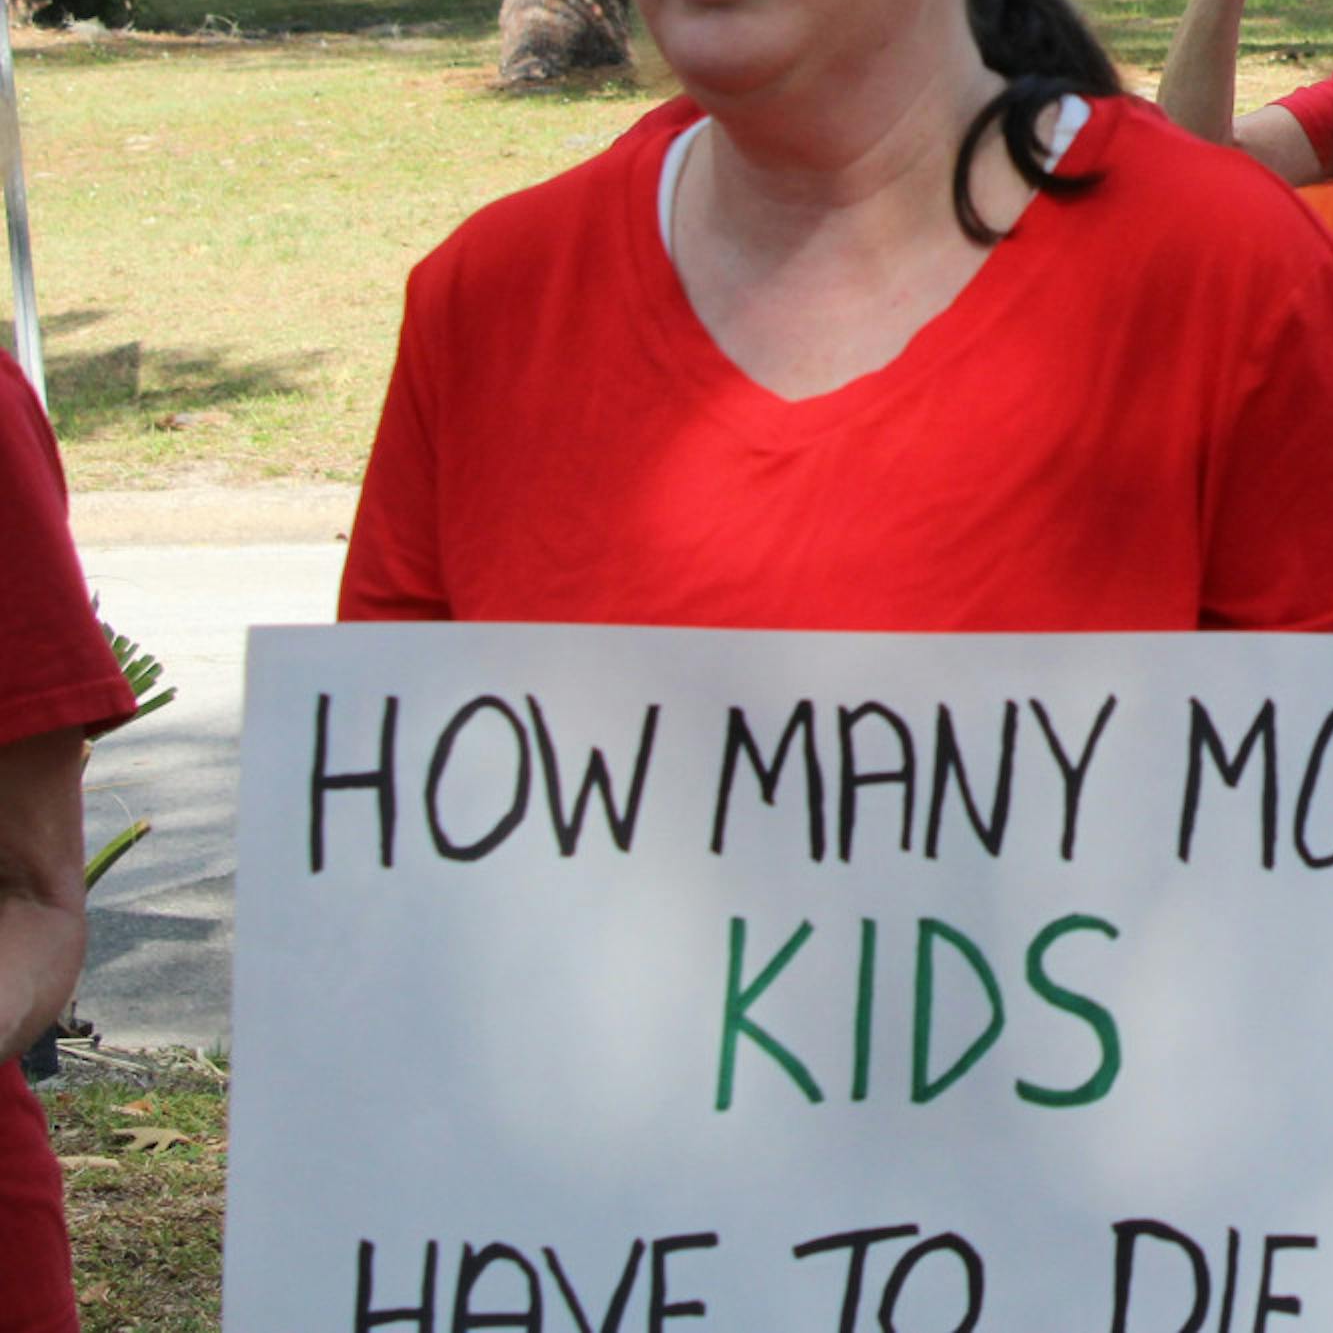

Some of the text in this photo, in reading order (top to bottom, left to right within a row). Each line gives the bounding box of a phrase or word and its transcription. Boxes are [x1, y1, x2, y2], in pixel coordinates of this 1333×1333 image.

[309, 693, 661, 874] HOW
[710, 695, 1118, 864] MANY
[716, 913, 1123, 1112] KIDS
[353, 1232, 719, 1333] HAVE
[792, 1223, 986, 1333] TO
